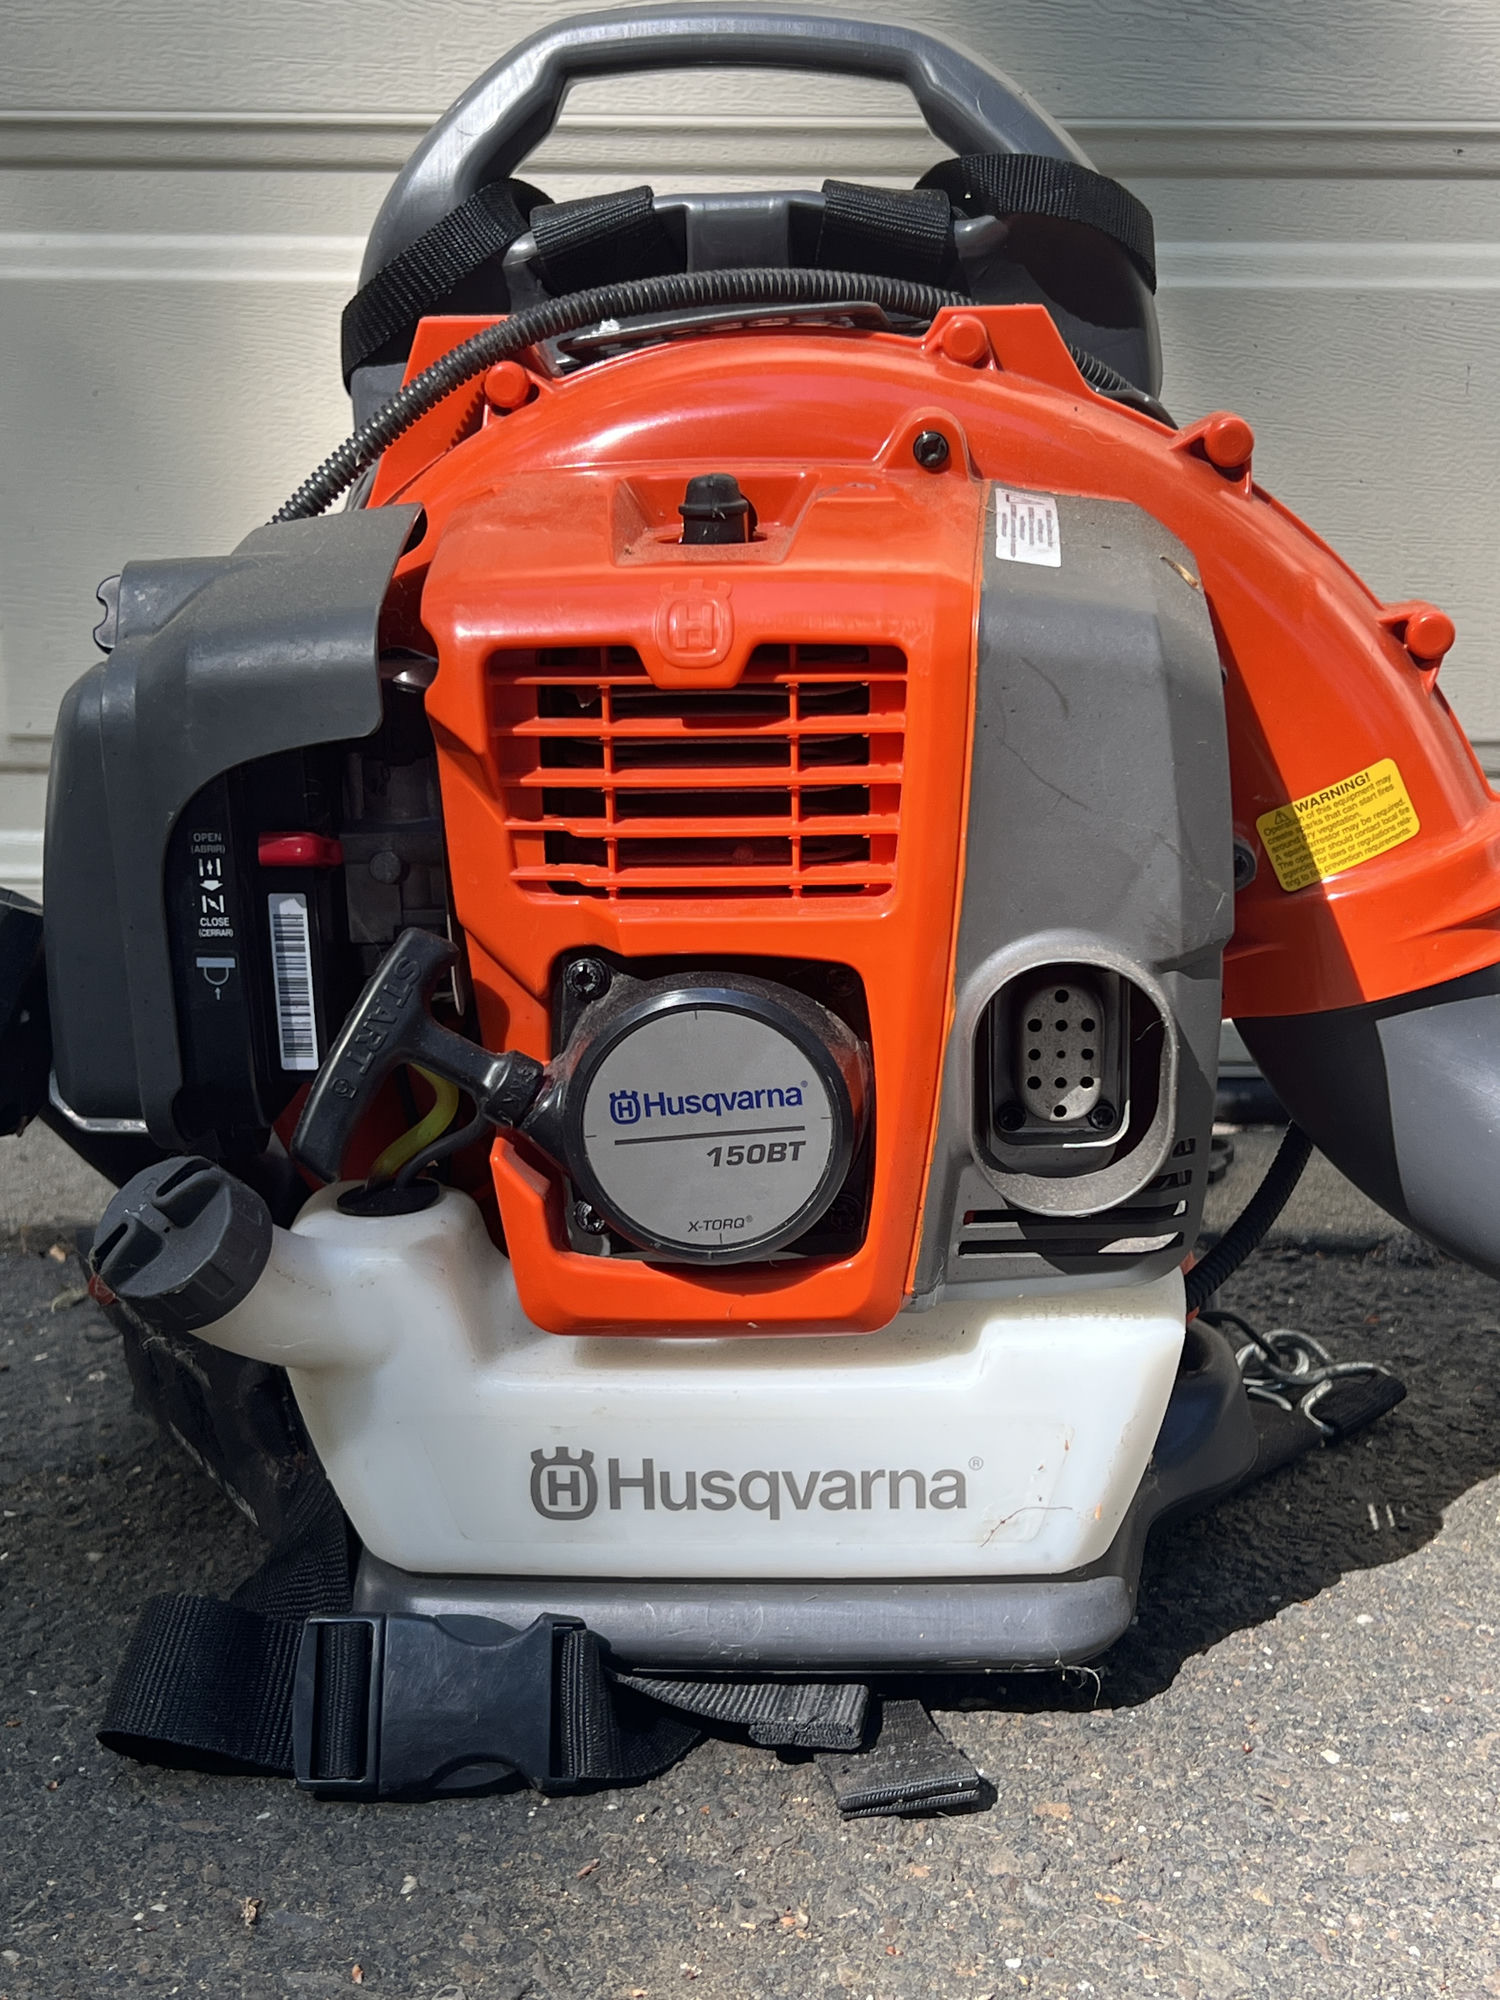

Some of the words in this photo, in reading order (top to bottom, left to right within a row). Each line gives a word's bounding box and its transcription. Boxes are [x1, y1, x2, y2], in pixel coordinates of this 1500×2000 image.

[1294, 772, 1371, 813] WARNING!
[1305, 809, 1314, 818] of
[1315, 803, 1331, 814] this
[1332, 783, 1375, 808] equipment
[1375, 774, 1392, 786] may
[1324, 809, 1341, 821] that
[1342, 802, 1357, 813] can
[1358, 792, 1377, 805] start
[1377, 784, 1393, 795] fires
[1317, 810, 1361, 835] vegetation.
[1342, 821, 1359, 834] may
[1360, 815, 1371, 825] be
[1372, 798, 1406, 820] required.
[191, 844, 226, 854] (ABRIR)
[193, 832, 222, 842] OPEN
[1278, 859, 1293, 870] The
[1327, 834, 1352, 849] should
[1353, 821, 1380, 838] contact
[1381, 812, 1398, 824] local
[1398, 806, 1409, 815] fire
[1317, 855, 1327, 864] for
[1356, 824, 1396, 848] regulations
[1301, 873, 1309, 881] to
[1323, 850, 1363, 871] prevention
[198, 928, 234, 938] (CERRAR)
[200, 917, 230, 927] CLOSE
[346, 956, 422, 1075] START
[706, 1140, 807, 1168] 150BT
